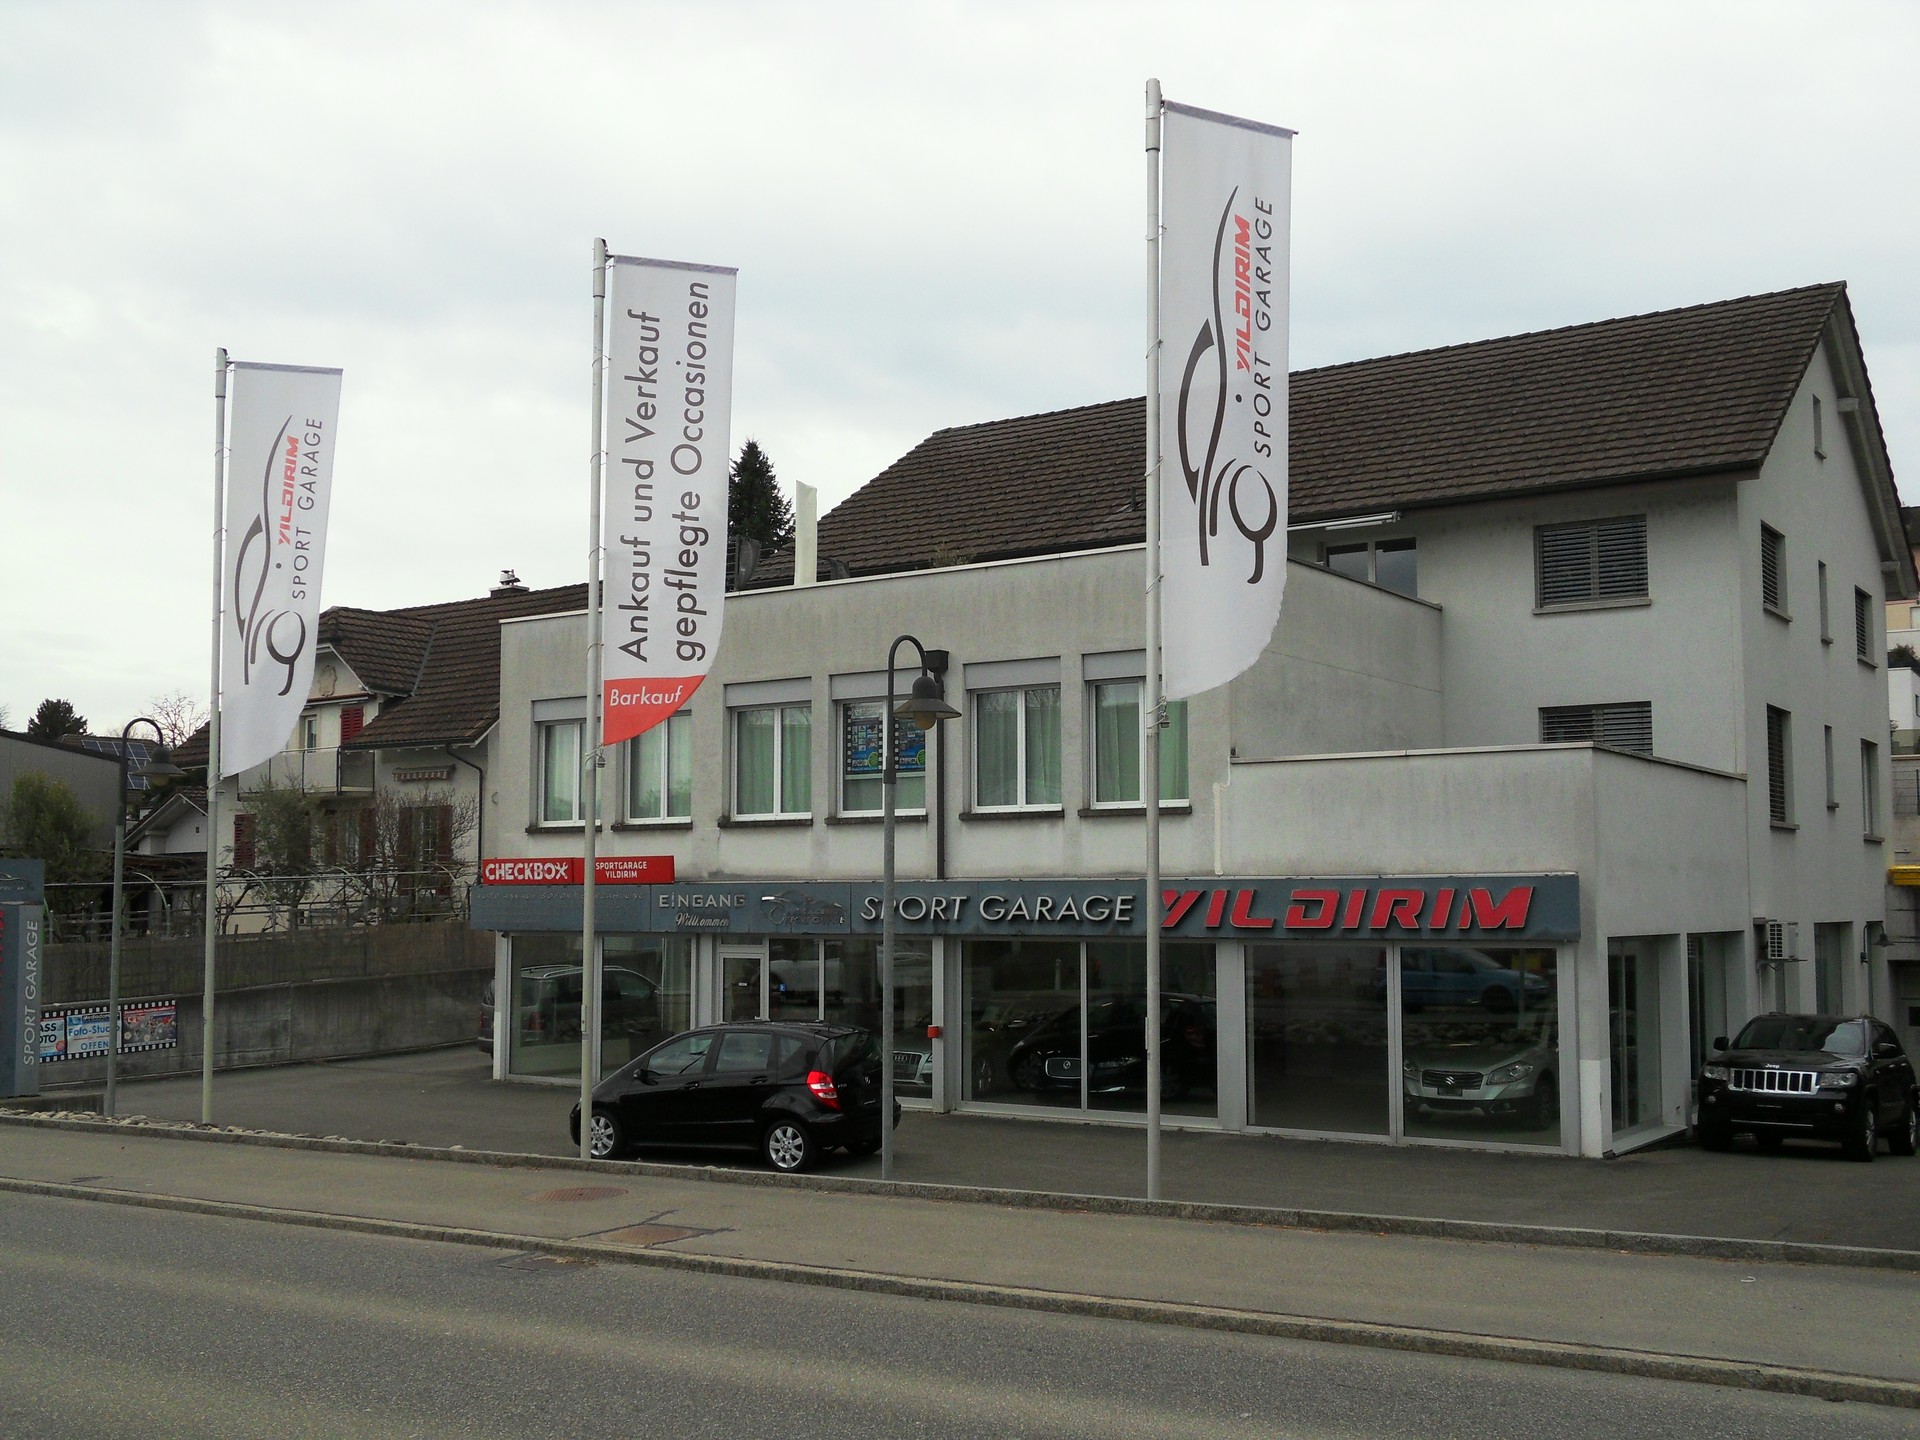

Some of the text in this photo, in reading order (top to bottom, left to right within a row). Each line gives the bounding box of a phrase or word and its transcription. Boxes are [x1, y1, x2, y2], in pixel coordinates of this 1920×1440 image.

[1235, 213, 1251, 373] YILDIRIM
[1253, 196, 1274, 459] SPORT GARAGE
[277, 435, 298, 545] YILDIRIM
[291, 417, 323, 601] SPORT GARAGE
[617, 308, 661, 664] Ankauf und Verkauf
[664, 281, 709, 662] gepflegte Occasionen
[609, 684, 684, 708] Barkauf
[485, 862, 569, 881] CHECKBOX
[595, 861, 648, 871] SPORTGARAGE
[605, 870, 639, 879] YILDIRIM
[979, 895, 1137, 921] GARAGE
[1160, 886, 1534, 929] YILDIRIM
[23, 920, 39, 1066] SPORT GARAGE
